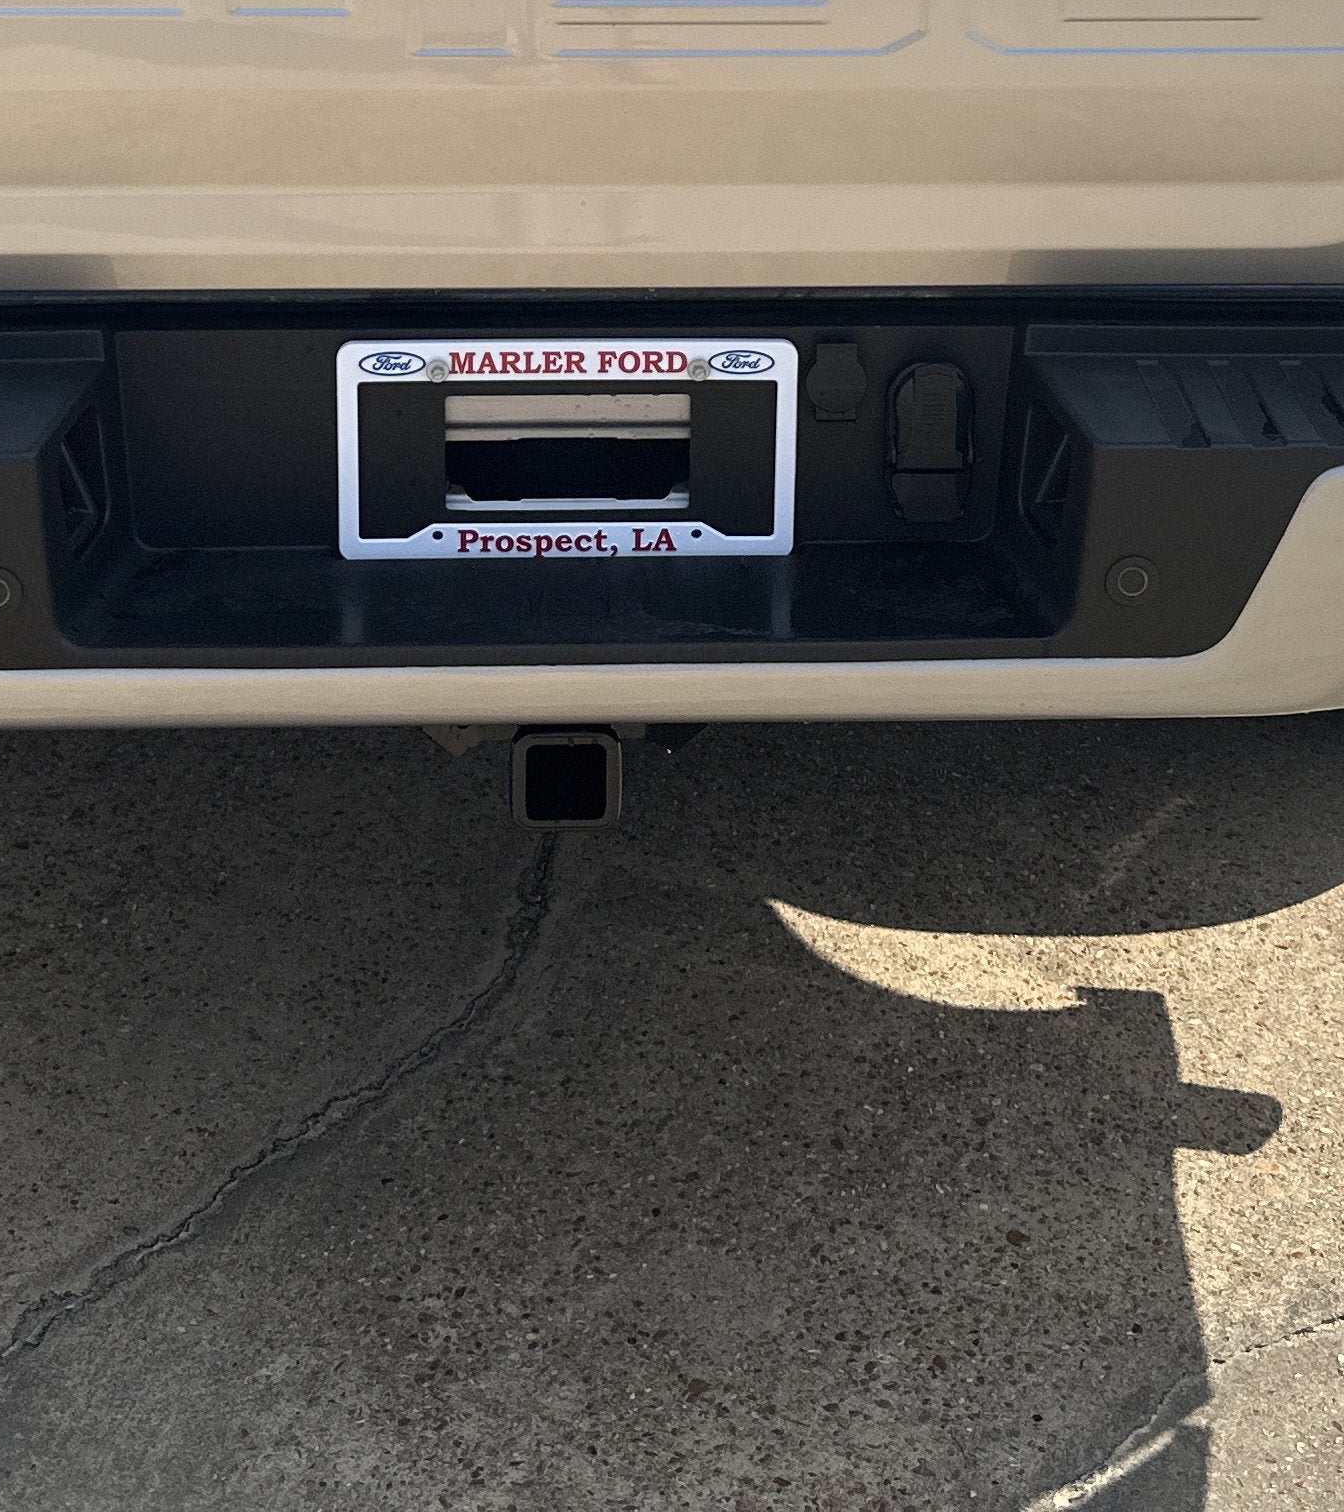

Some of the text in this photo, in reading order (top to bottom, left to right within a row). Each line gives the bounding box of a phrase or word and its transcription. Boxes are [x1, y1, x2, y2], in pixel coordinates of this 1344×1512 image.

[371, 351, 412, 373] Ford
[448, 351, 688, 375] MARLER FORD
[721, 350, 762, 371] Ford
[457, 528, 677, 559] Prospect, LA
